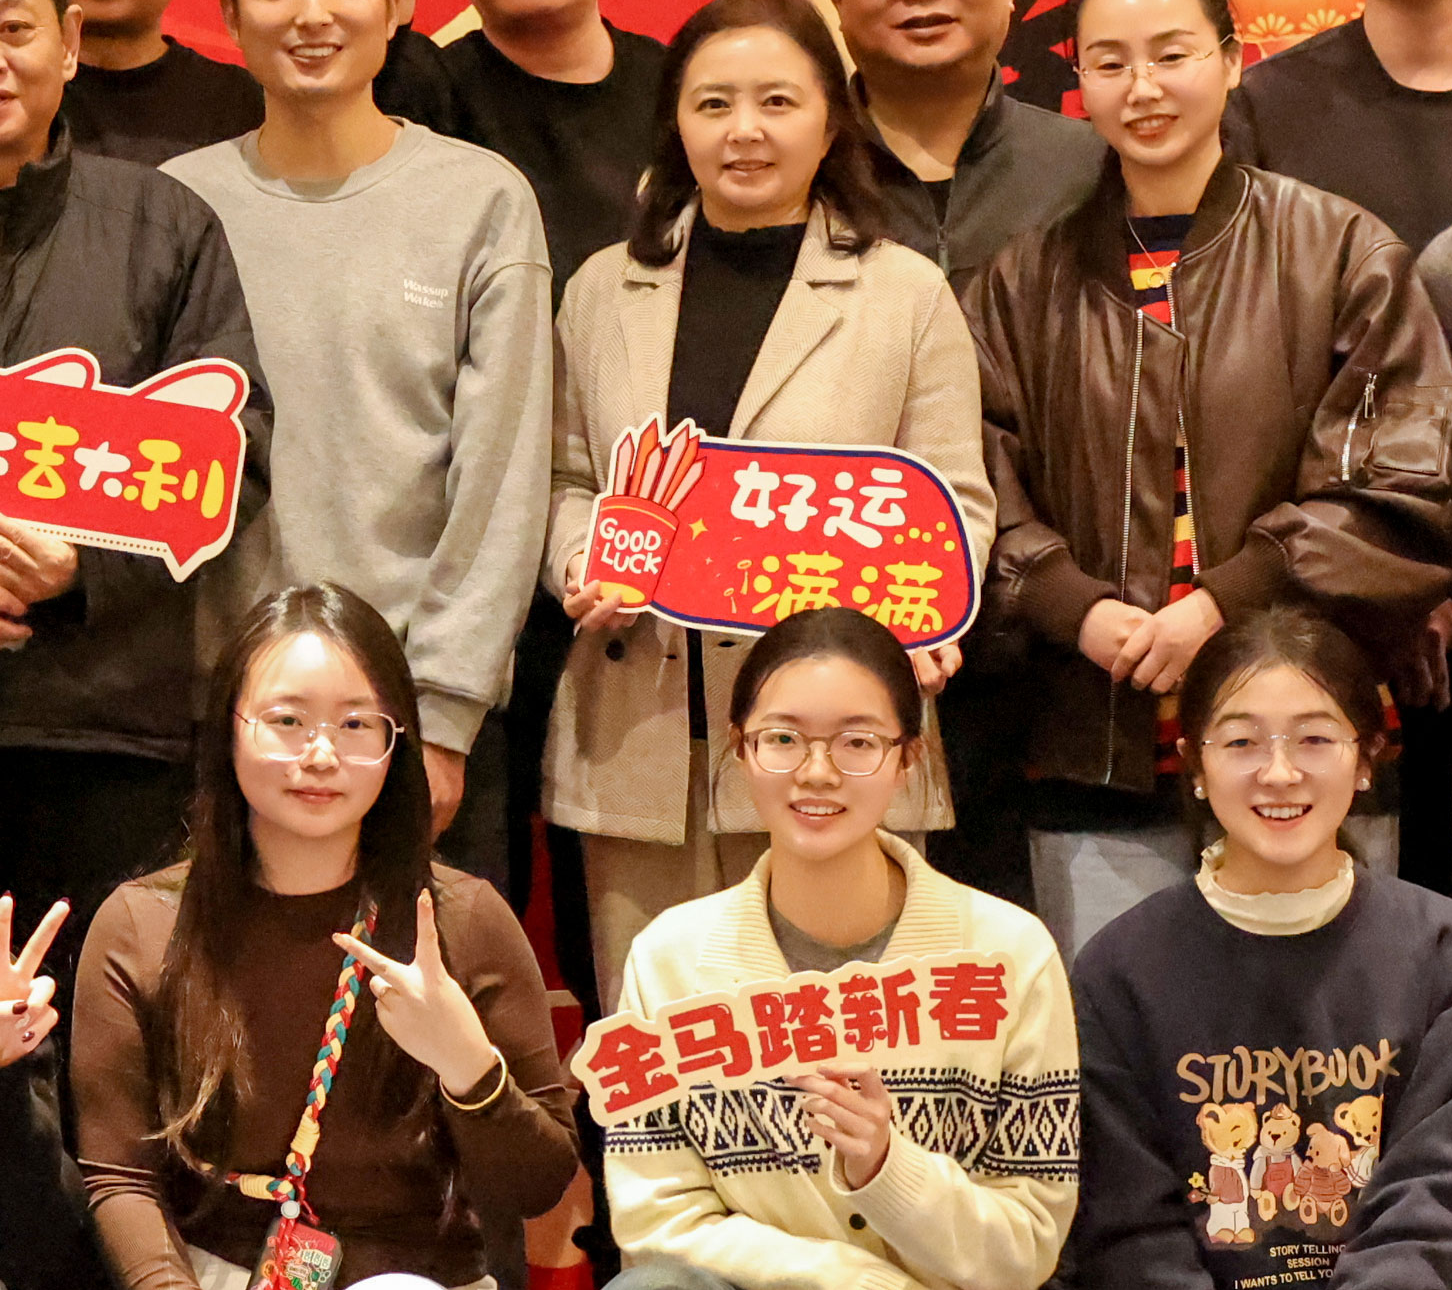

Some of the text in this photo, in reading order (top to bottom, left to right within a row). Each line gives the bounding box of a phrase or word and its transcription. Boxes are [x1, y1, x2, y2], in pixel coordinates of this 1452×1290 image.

[731, 461, 907, 549] 好运
[599, 518, 662, 553] GOOD
[600, 548, 659, 576] LUCK
[751, 551, 944, 634] 满满
[586, 962, 1009, 1114] 金马踏新春
[1176, 1038, 1401, 1111] STORYBOOK
[1269, 1244, 1300, 1257] STORY
[1286, 1257, 1330, 1269] SESSION
[1234, 1269, 1337, 1289] I WANTS TO TELL YO
